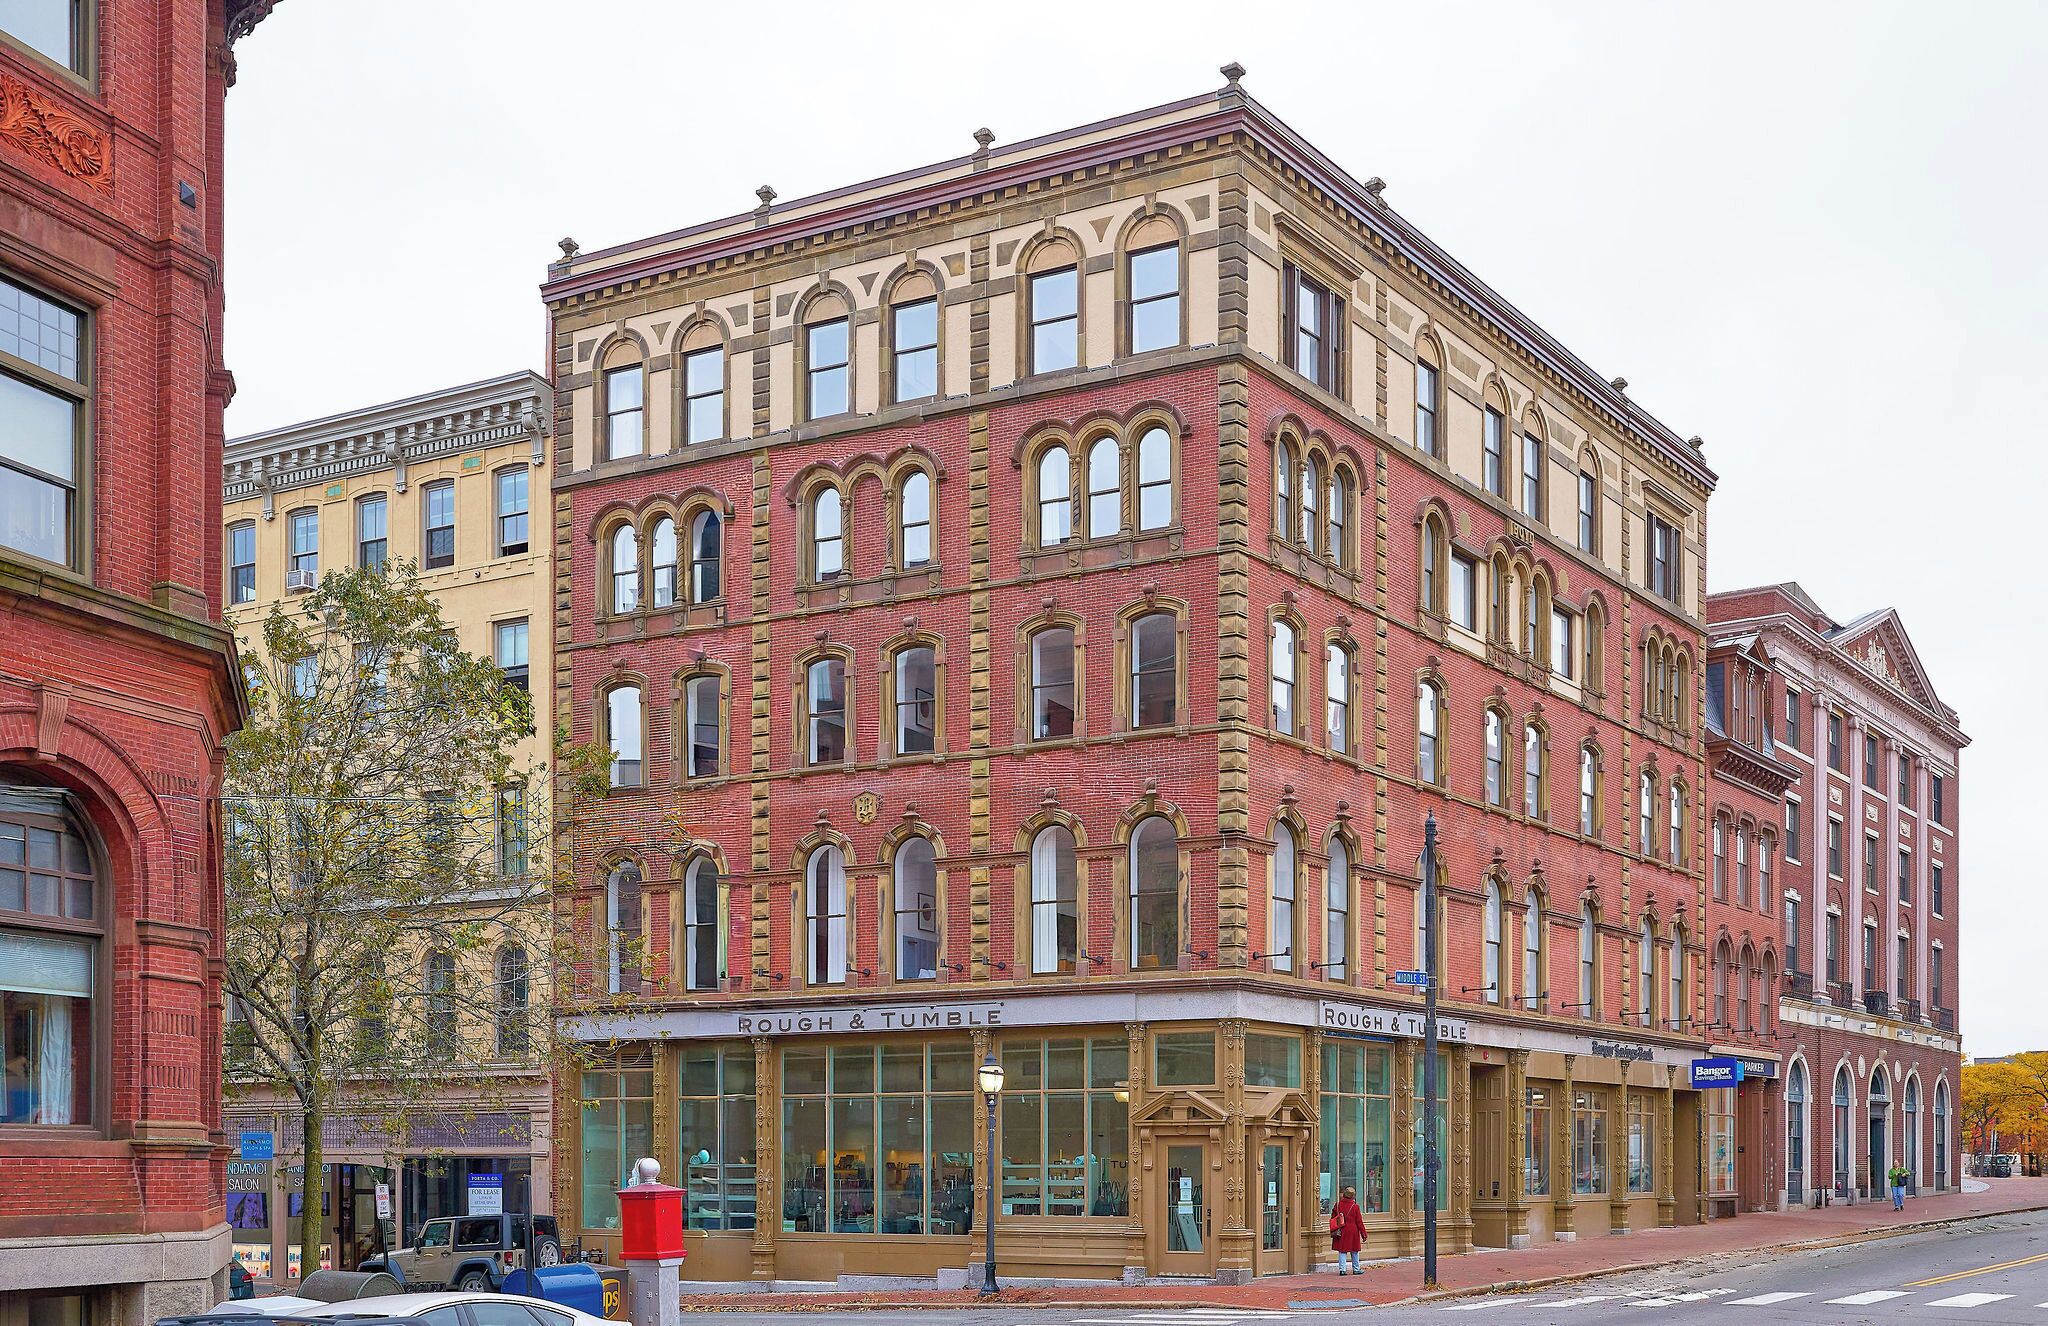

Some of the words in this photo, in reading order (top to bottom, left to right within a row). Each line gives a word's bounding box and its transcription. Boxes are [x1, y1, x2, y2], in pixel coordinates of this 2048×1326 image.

[1396, 972, 1417, 983] MIDDLE
[738, 1016, 833, 1033] ROUGH
[850, 1013, 865, 1030] &
[881, 1010, 1001, 1028] TUMBLE
[1324, 1008, 1383, 1030] ROUGH
[1391, 1017, 1400, 1033] &
[1408, 1019, 1467, 1040] TUBLE
[1695, 1066, 1731, 1076] Bangor
[1744, 1062, 1765, 1073] PARKER
[227, 1162, 267, 1174] NDIAMO!
[228, 1178, 259, 1190] SALON
